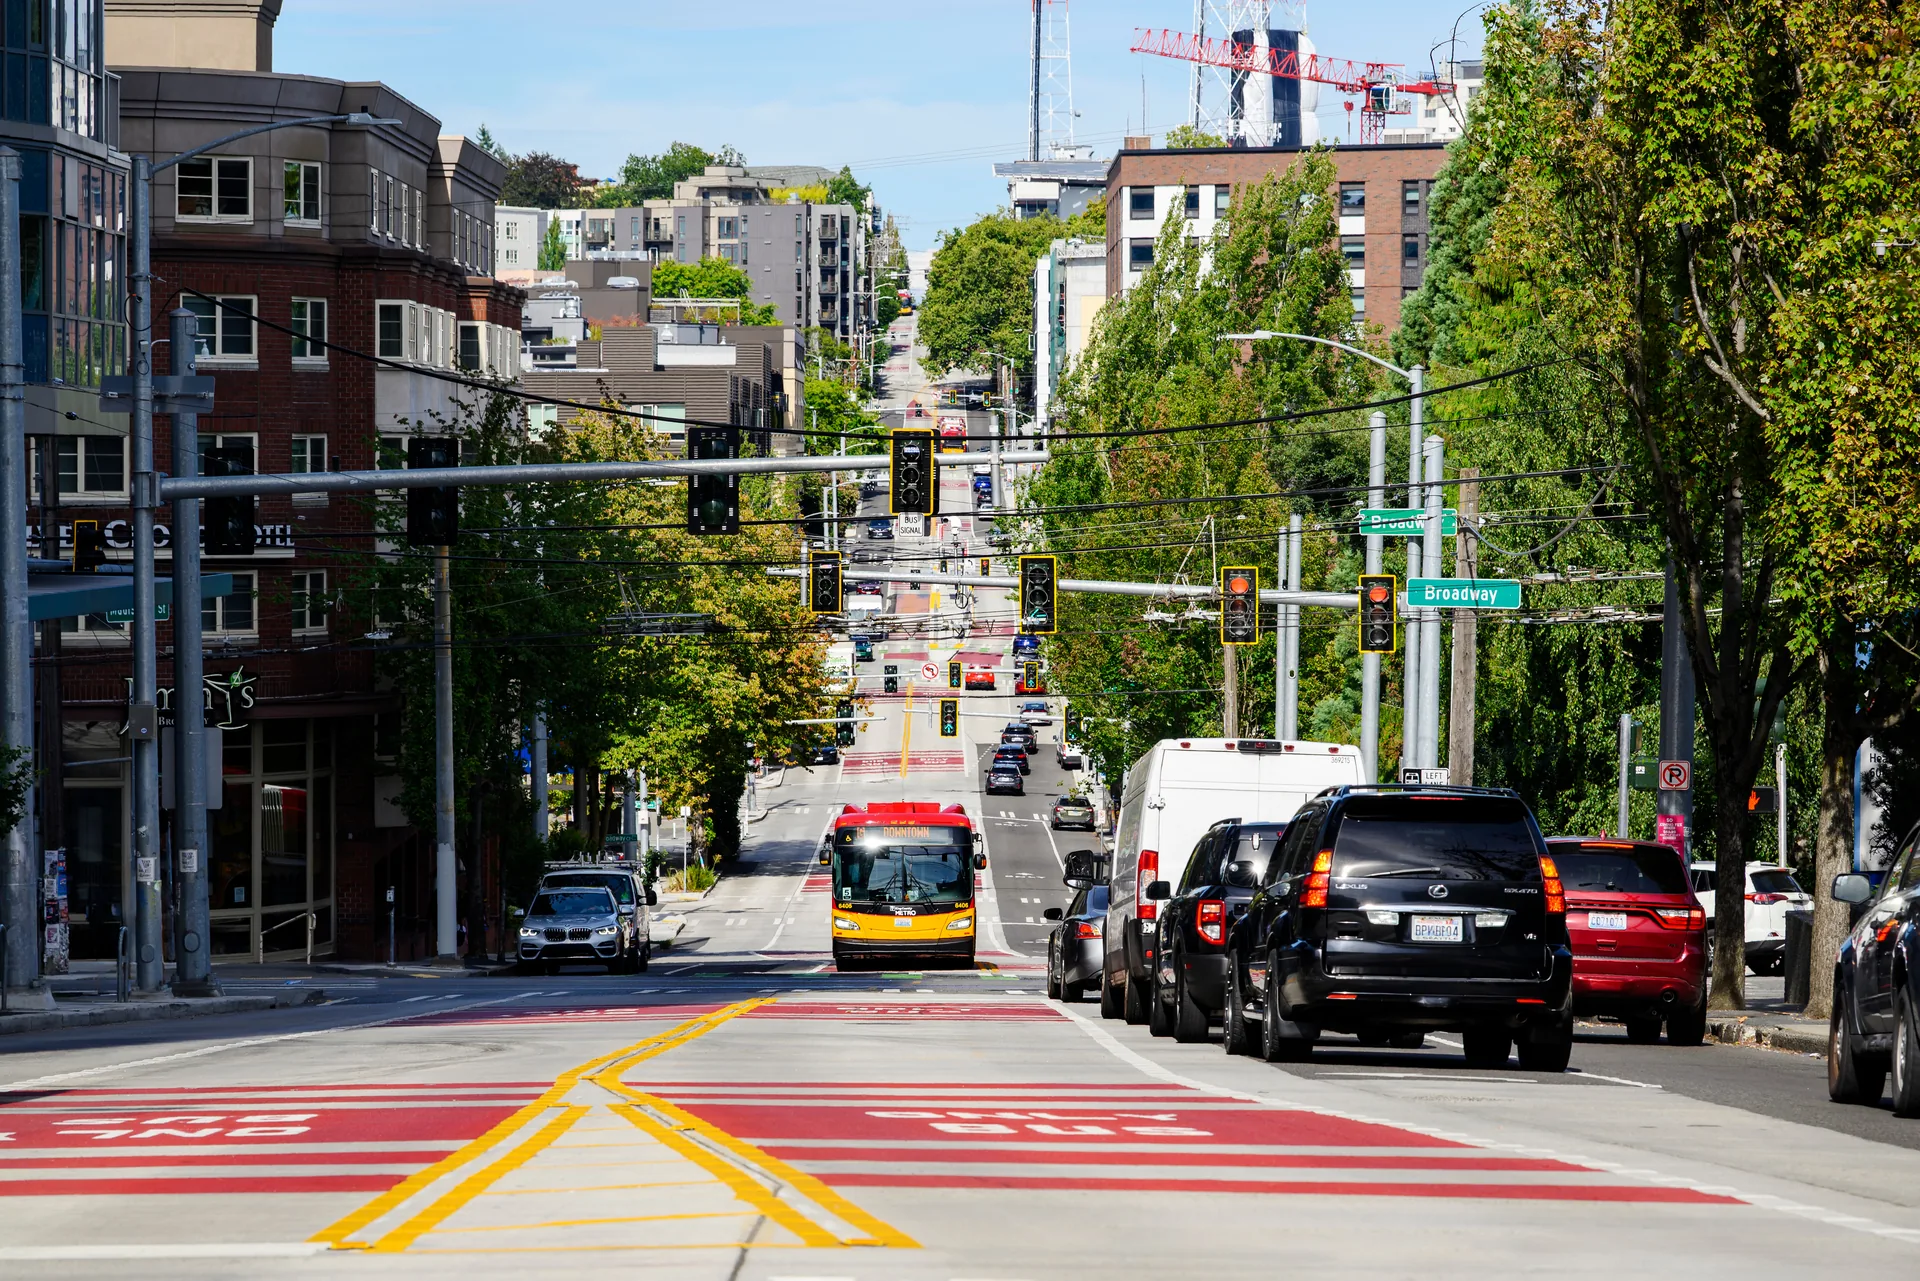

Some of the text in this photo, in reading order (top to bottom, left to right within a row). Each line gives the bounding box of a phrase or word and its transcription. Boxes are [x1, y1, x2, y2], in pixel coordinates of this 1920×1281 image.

[904, 516, 918, 524] BUS
[900, 526, 921, 534] SIGNAL
[1425, 585, 1497, 604] Broadway
[883, 826, 930, 838] DOWNTOWN
[865, 1110, 1178, 1121] ONLY
[929, 1122, 1214, 1136] BUS
